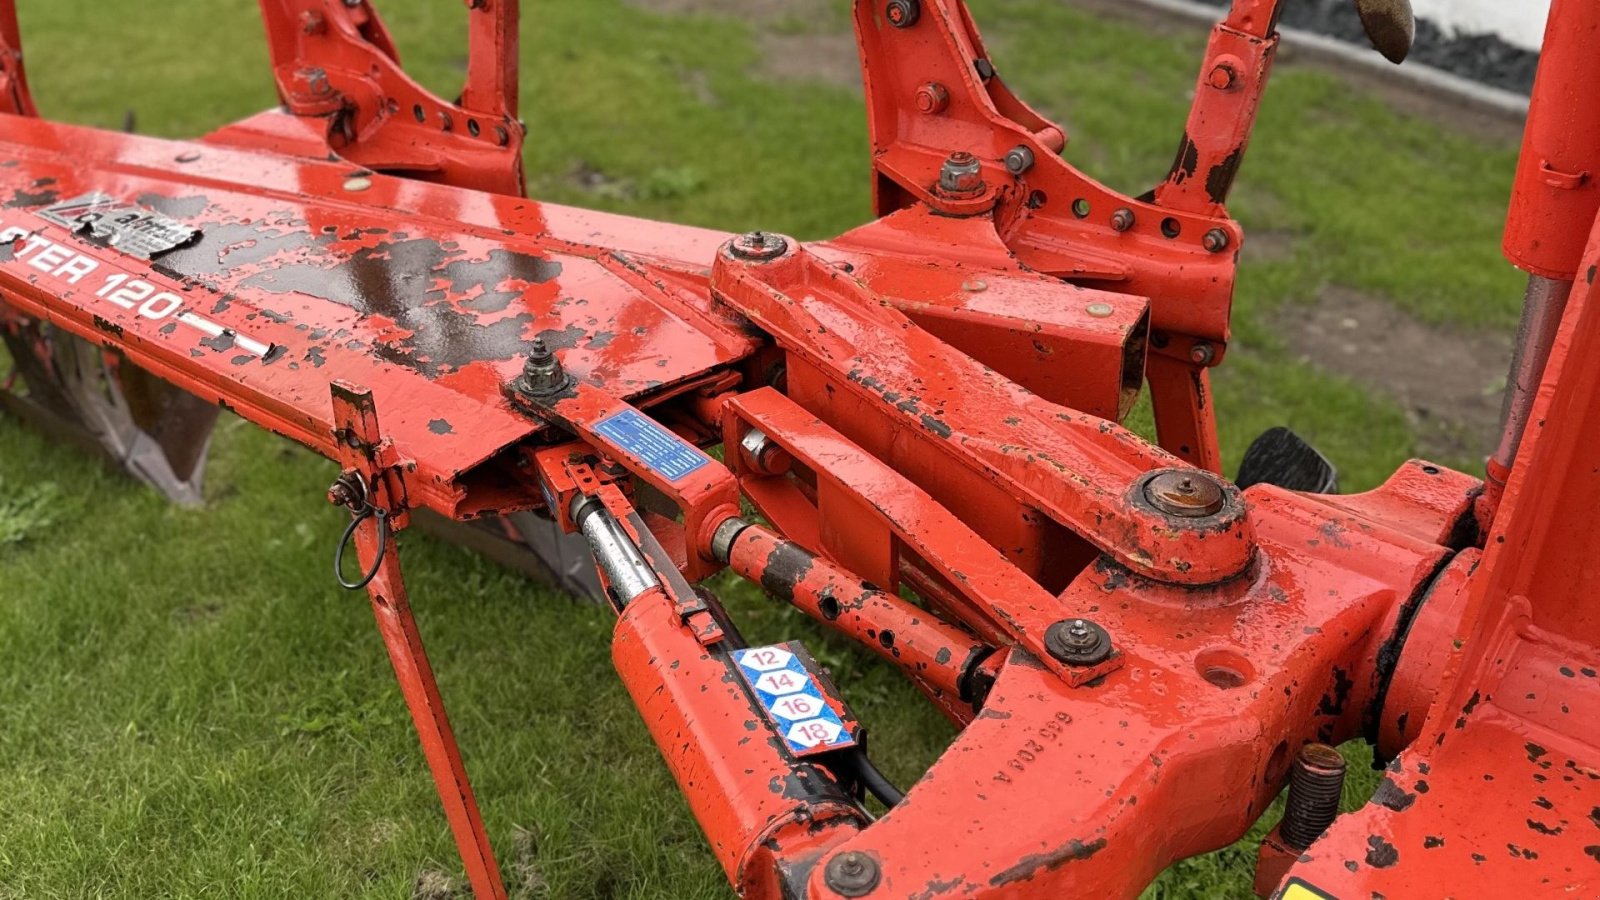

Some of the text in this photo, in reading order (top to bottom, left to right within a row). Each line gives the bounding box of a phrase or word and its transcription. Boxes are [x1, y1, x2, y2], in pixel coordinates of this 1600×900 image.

[95, 273, 183, 320] 120
[751, 650, 779, 666] 12
[766, 673, 795, 690] 14
[782, 698, 811, 715] 16
[798, 723, 829, 741] 18
